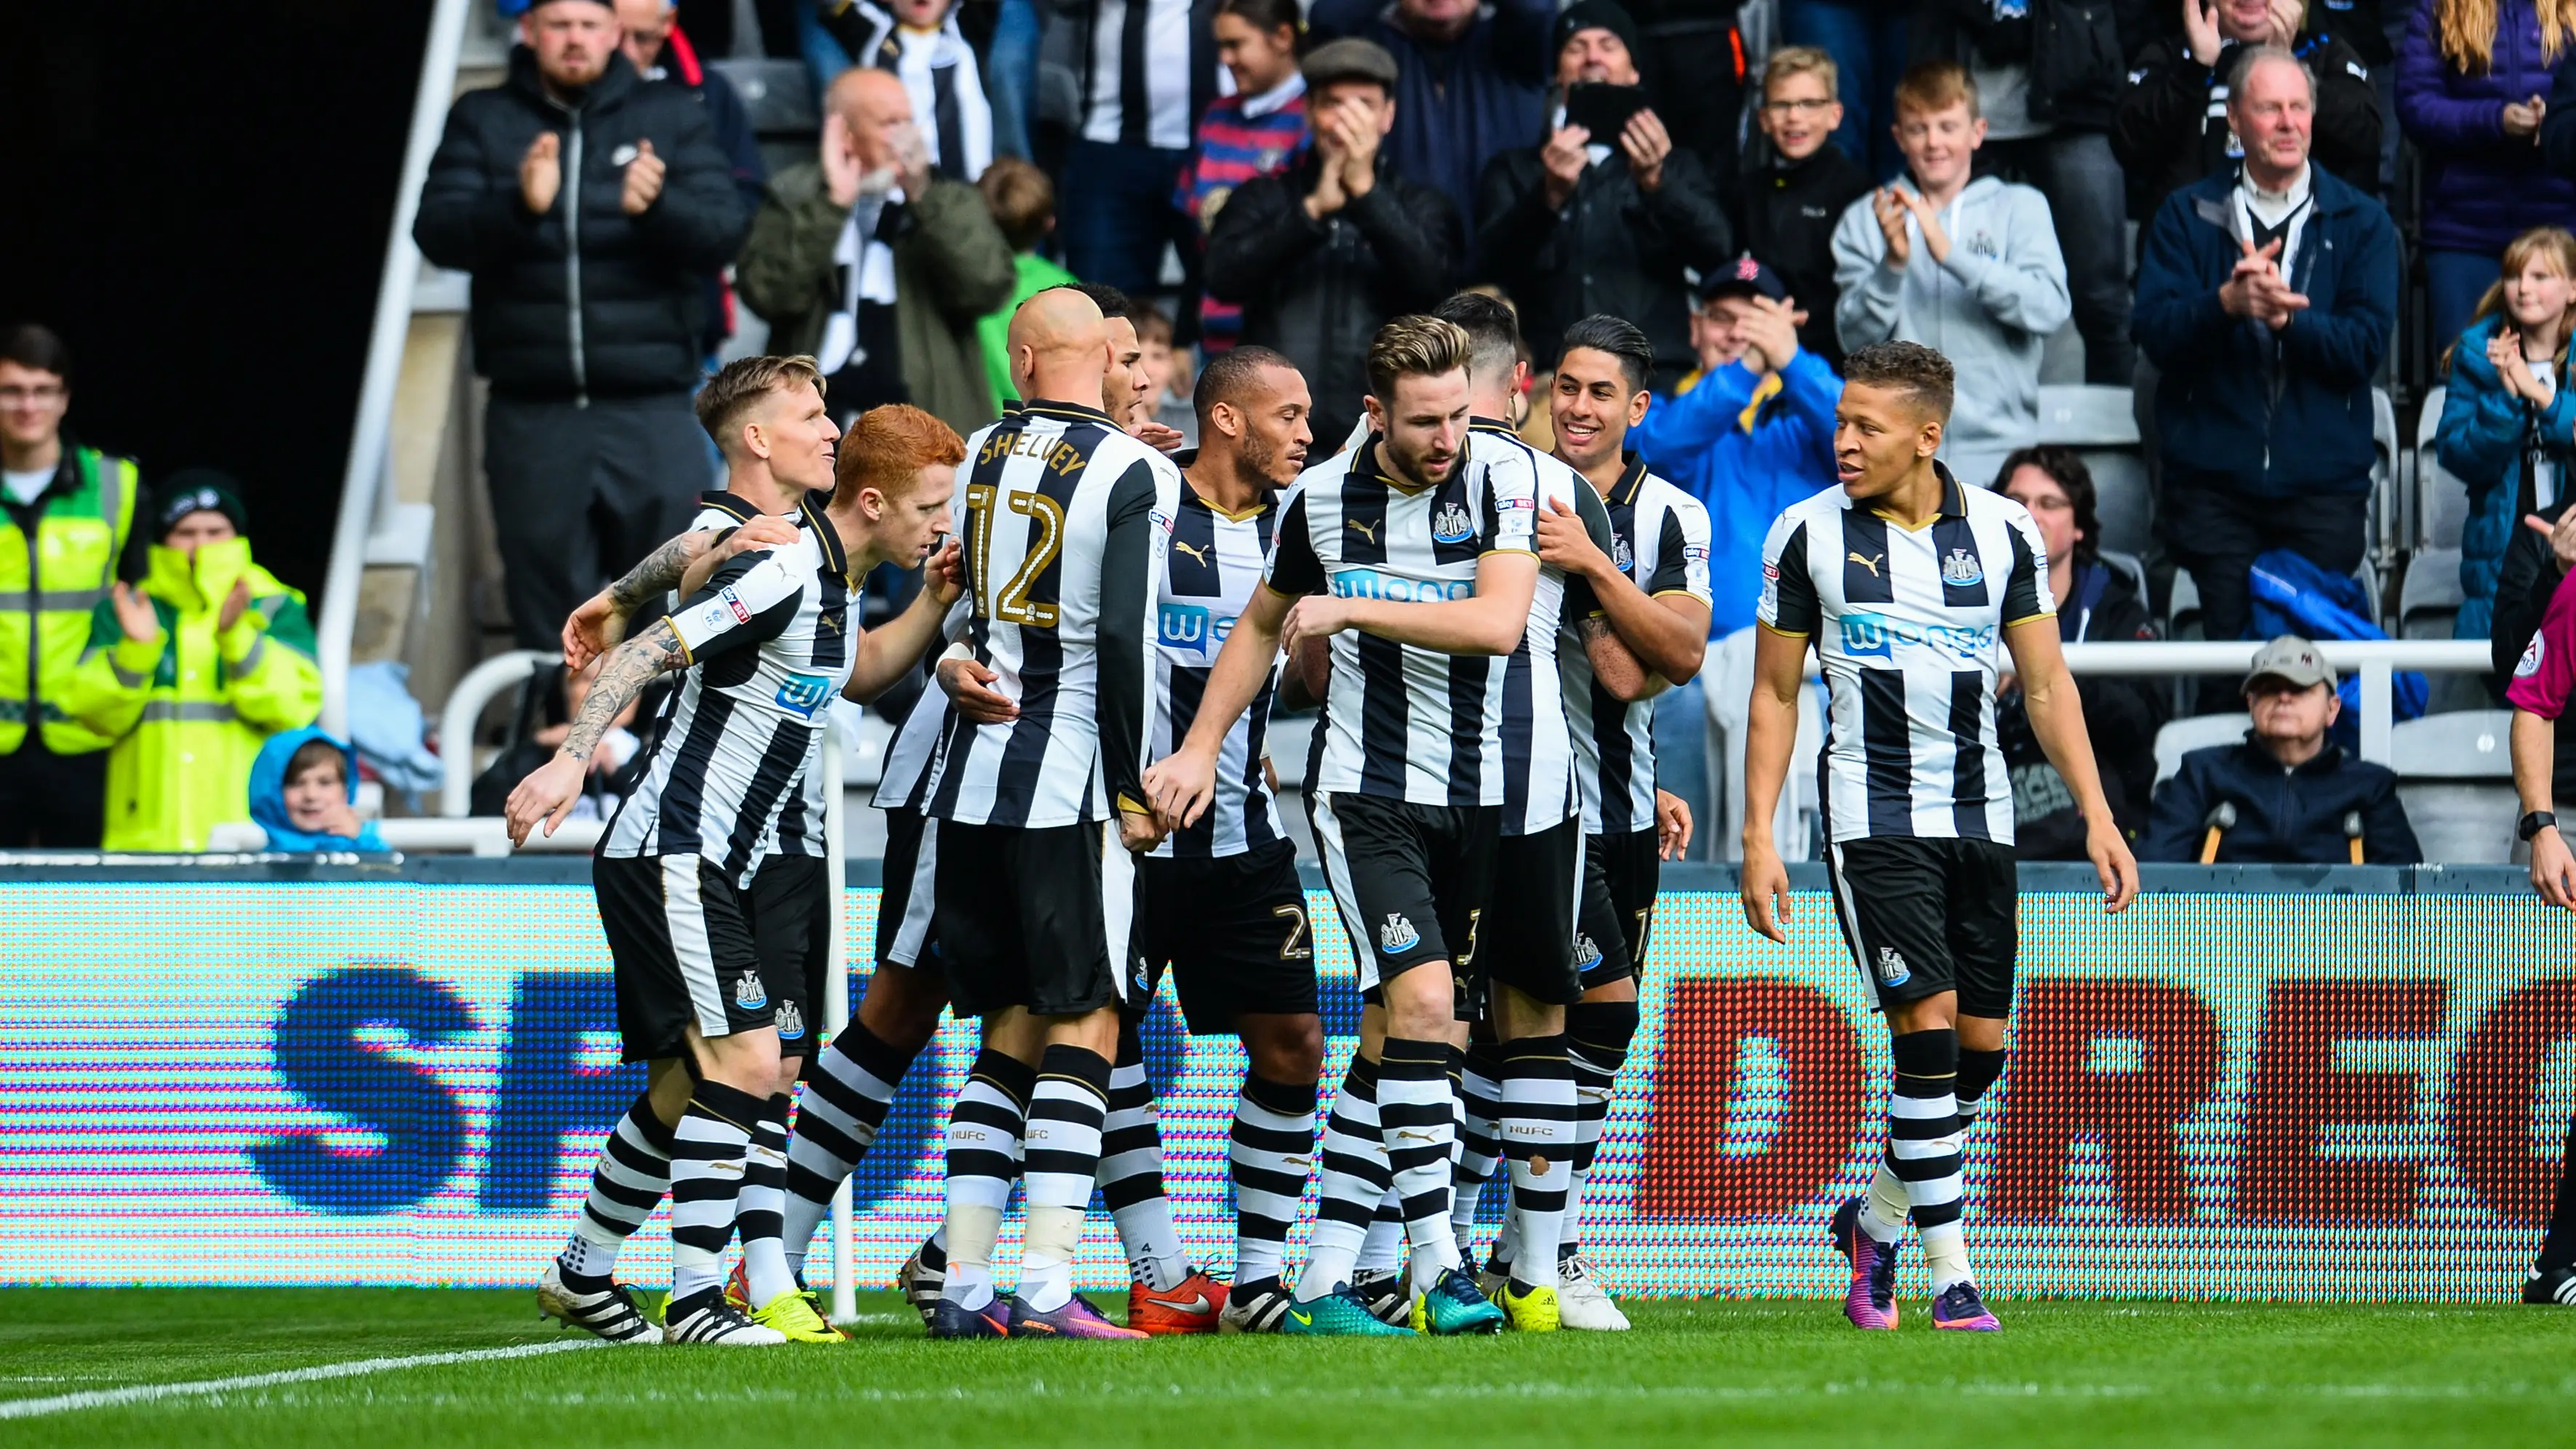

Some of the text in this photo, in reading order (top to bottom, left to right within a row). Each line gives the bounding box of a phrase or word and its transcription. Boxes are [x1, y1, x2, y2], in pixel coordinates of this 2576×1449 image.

[980, 432, 1087, 476] SHELVEY
[1498, 500, 1533, 509] sky BET
[965, 483, 1065, 628] 12
[722, 588, 748, 621] sky BET
[1844, 622, 1994, 658] wonga
[1272, 903, 1311, 960] 2
[1456, 908, 1481, 966] 3
[951, 1130, 986, 1141] NUFC
[1026, 1130, 1049, 1140] UFC
[1509, 1125, 1553, 1136] NUFC
